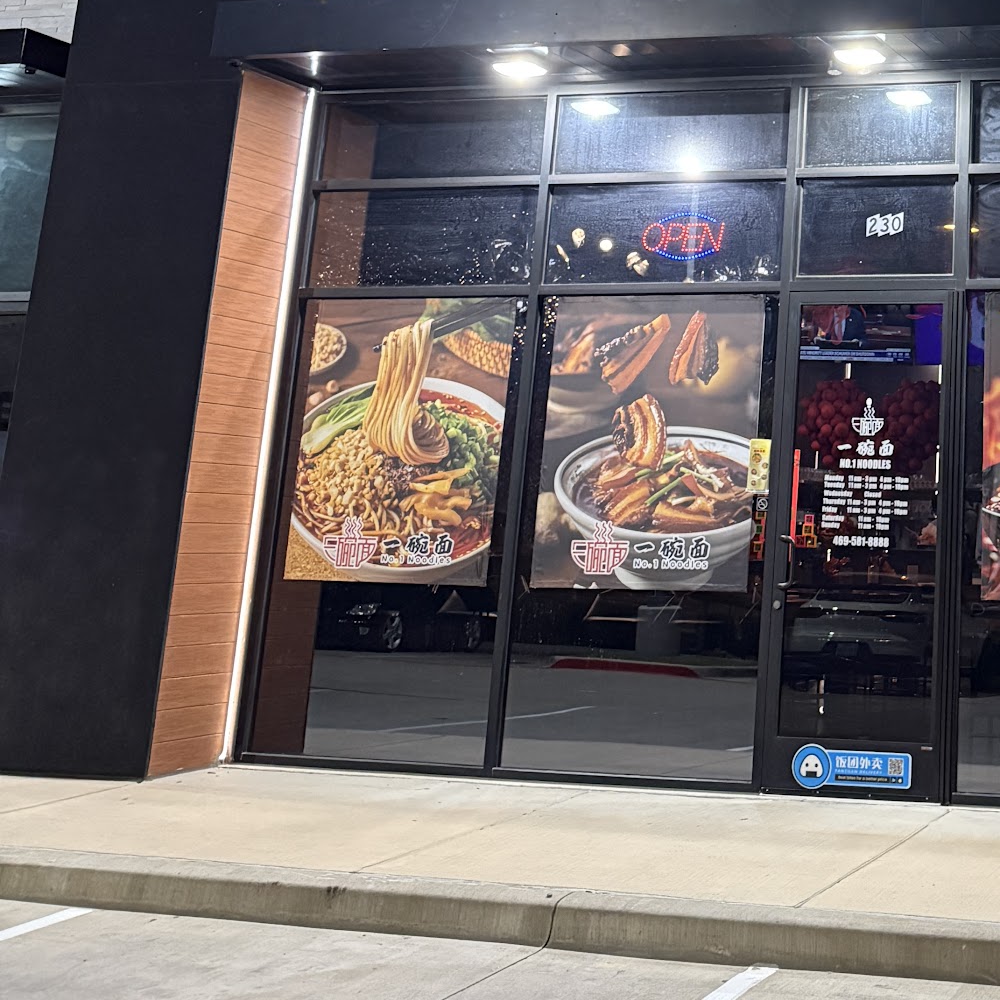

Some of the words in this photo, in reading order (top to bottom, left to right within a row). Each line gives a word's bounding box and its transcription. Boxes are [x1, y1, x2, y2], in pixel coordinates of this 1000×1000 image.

[867, 213, 903, 235] 230
[642, 222, 725, 252] OPEN
[837, 439, 894, 456] 一碗面
[822, 514, 844, 522] Saturday
[382, 533, 454, 555] 一碗面
[634, 536, 710, 559] 一碗面
[381, 555, 404, 564] No.1
[408, 555, 451, 565] Noodles
[633, 558, 658, 569] No.1
[662, 558, 709, 570] Noodles
[836, 756, 883, 769] 饭团外卖
